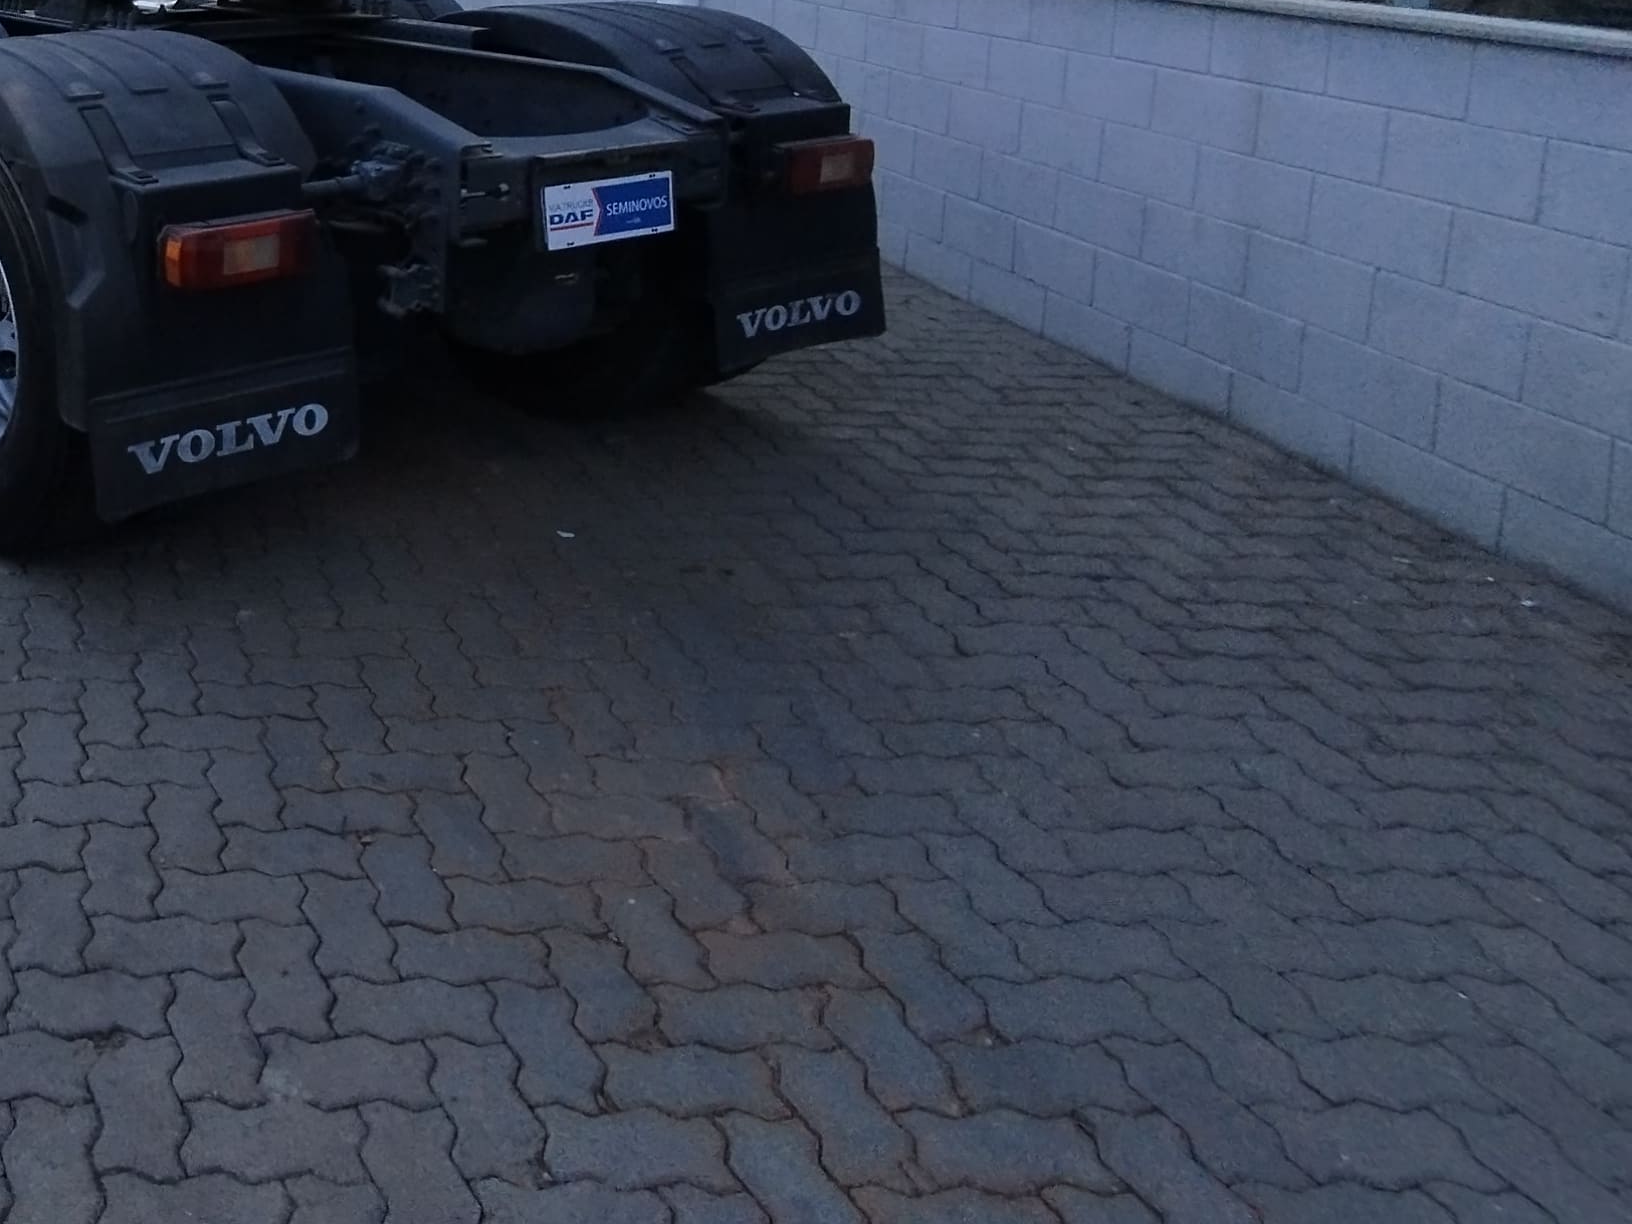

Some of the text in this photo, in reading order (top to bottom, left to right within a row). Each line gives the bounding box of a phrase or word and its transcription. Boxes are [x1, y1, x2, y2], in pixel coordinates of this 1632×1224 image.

[549, 209, 594, 226] DAF
[606, 195, 668, 217] SEMINOVOS
[736, 290, 861, 338] VOLVO
[127, 403, 329, 475] VOLVO
